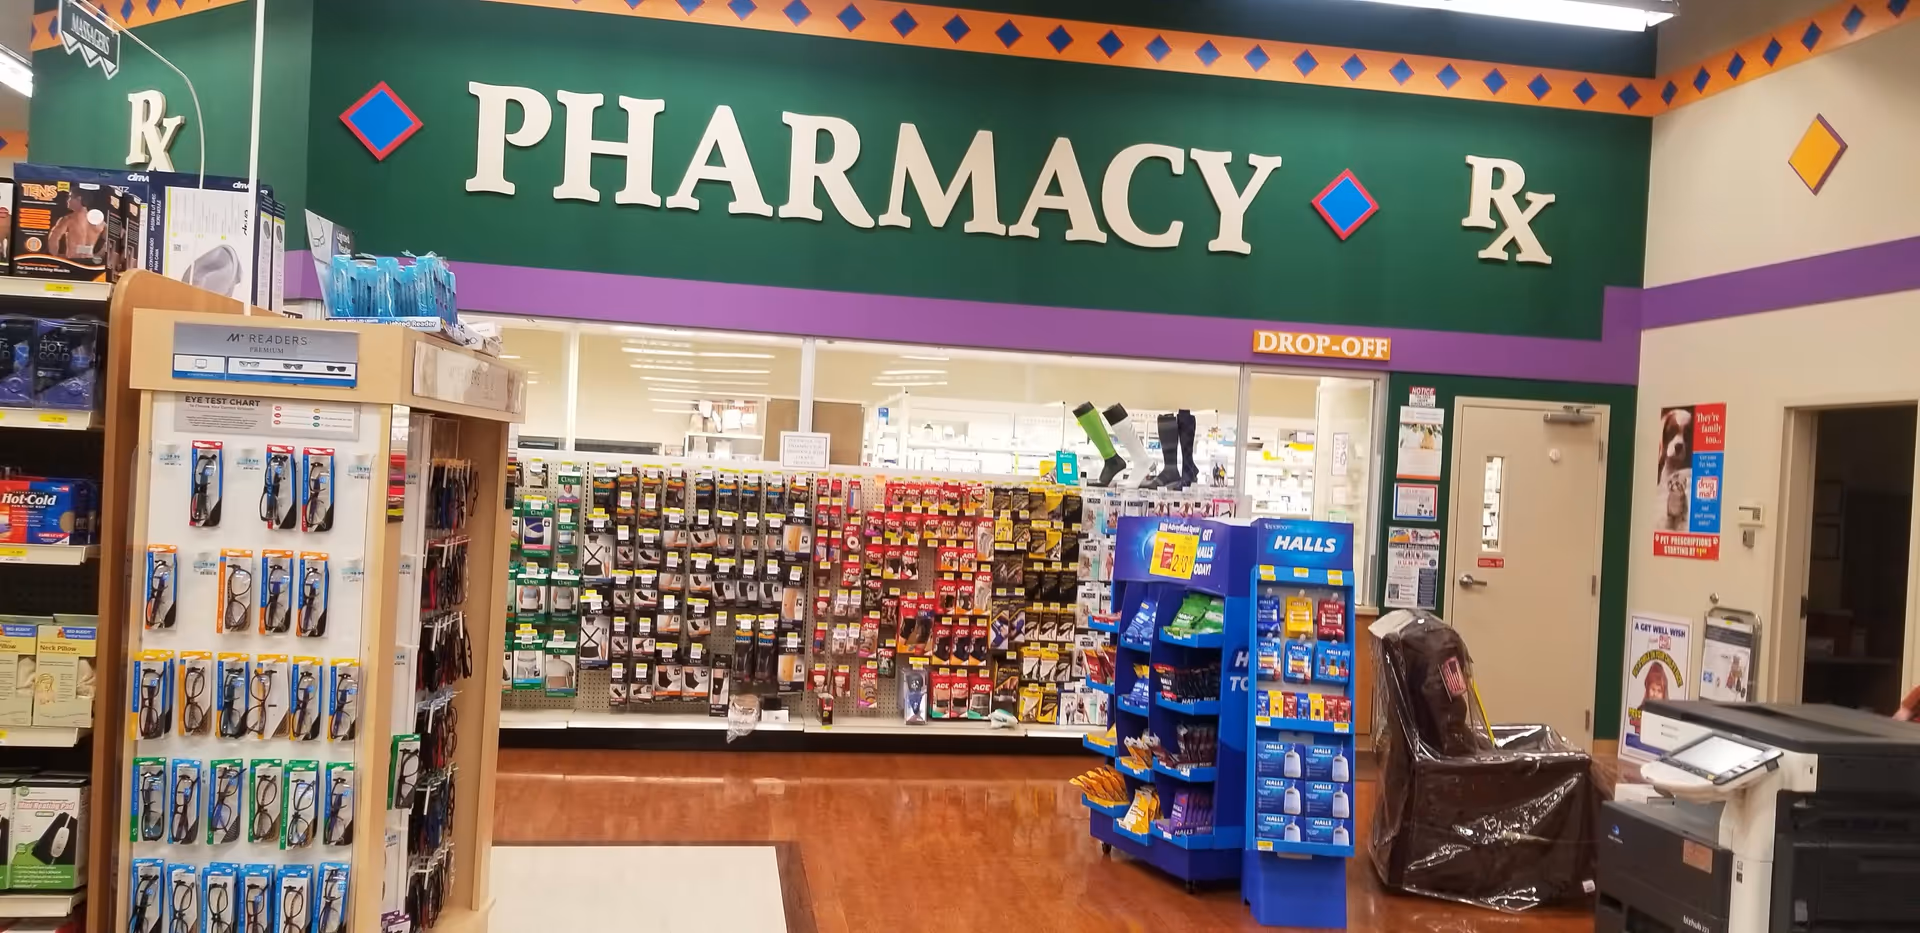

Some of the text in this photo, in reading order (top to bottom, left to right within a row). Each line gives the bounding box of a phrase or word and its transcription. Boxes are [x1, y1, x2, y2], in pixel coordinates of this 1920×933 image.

[71, 13, 109, 55] MASSAGERS
[465, 81, 1283, 255] PHARMACY
[249, 334, 308, 346] READERS
[1257, 331, 1389, 359] DROP-OFF
[1412, 387, 1435, 396] NOTICE
[185, 395, 261, 407] EYE TEST CHART
[1697, 413, 1720, 424] They're
[1701, 424, 1722, 435] family
[1698, 477, 1715, 490] drug
[1273, 535, 1337, 553] HALLS
[1670, 535, 1712, 548] PRESCRIPTIONS
[1664, 546, 1688, 556] STARTING
[1635, 622, 1686, 638] A GET WELL WISH
[1683, 914, 1702, 932] bizhub
